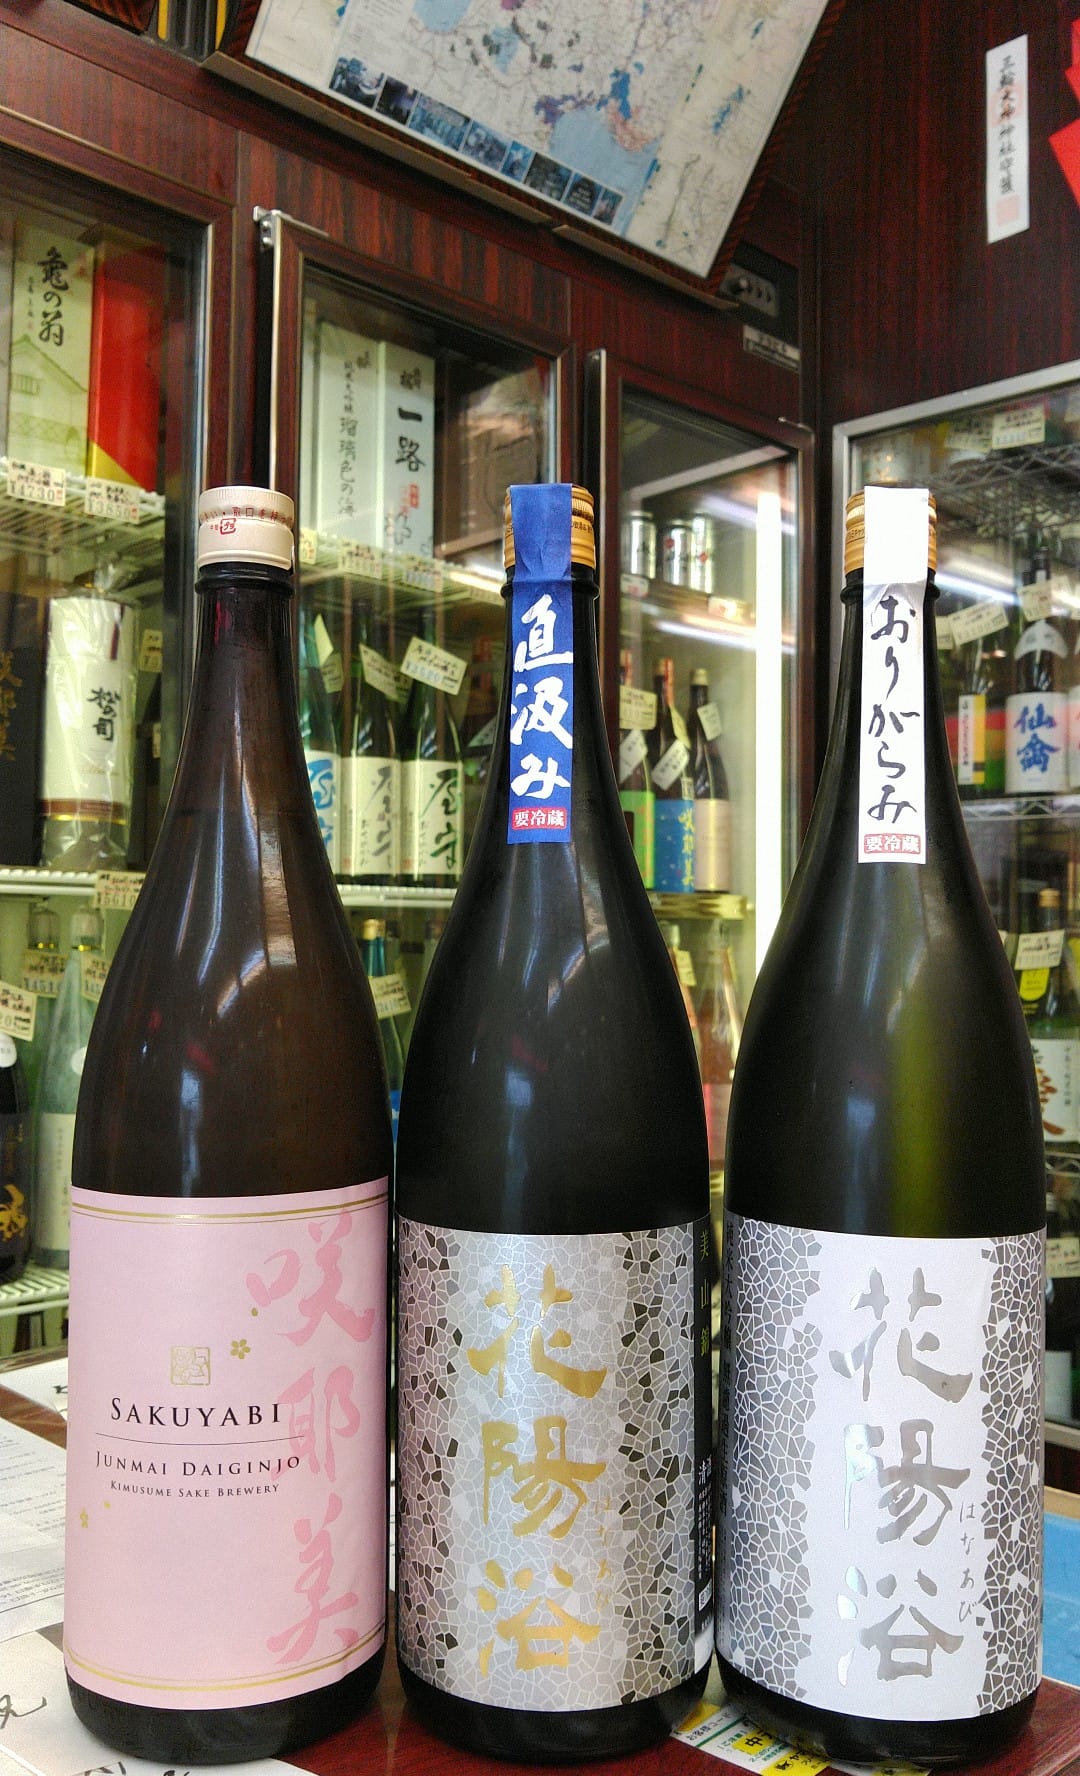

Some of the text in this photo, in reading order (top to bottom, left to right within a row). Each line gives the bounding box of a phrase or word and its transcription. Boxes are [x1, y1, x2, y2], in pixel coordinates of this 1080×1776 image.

[395, 406, 426, 473] 一路
[87, 687, 121, 741] 松の司
[509, 593, 574, 800] 直汲み
[866, 595, 920, 824] おりがらみ
[515, 809, 565, 826] 要冷蔵
[865, 837, 919, 854] 要冷蔵
[111, 1397, 281, 1427] SAKUYABI
[246, 1207, 375, 1665] 咲耶美
[96, 1450, 300, 1476] JUNMAI DAIGINJO
[111, 1480, 279, 1498] KIMUSUME SAKE BREWERY
[467, 1263, 608, 1679] 花陽浴
[829, 1267, 974, 1687] 花陽浴
[958, 1501, 978, 1623] はなあび
